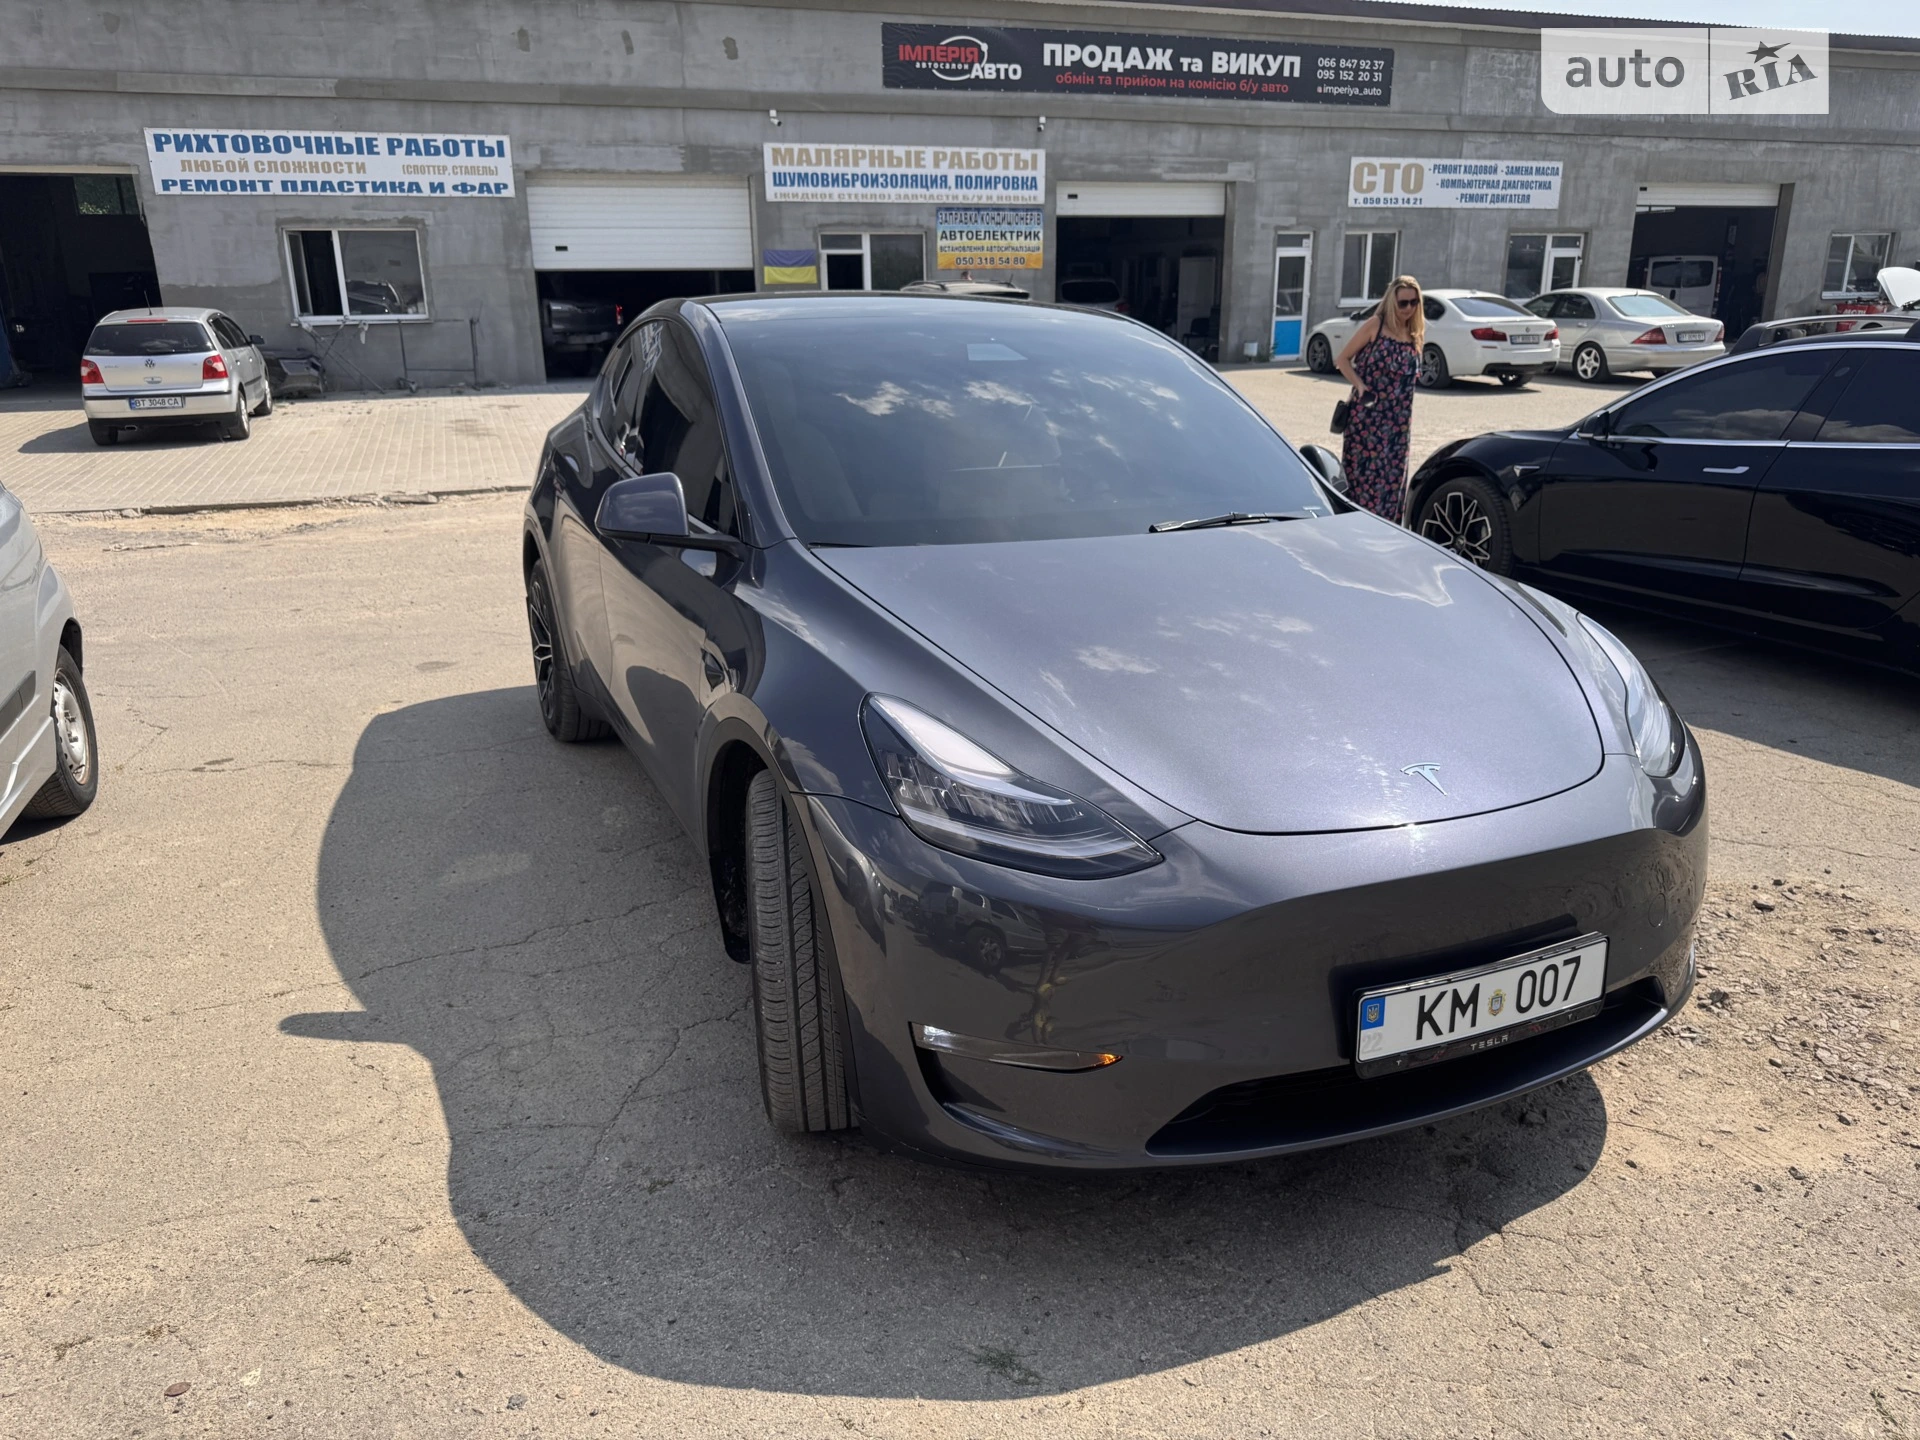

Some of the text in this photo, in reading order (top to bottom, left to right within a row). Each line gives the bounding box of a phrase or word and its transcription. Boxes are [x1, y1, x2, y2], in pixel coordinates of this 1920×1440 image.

[899, 44, 980, 63] ІМПЕРІЯ
[1043, 43, 1301, 78] ПРОДАЖ та ВИКУП
[915, 62, 969, 70] автосалон
[970, 62, 1022, 80] АВТО
[1317, 57, 1385, 70] 066 847 92 37
[1055, 72, 1289, 94] обмін та прийом на комісію б/у авто
[1317, 69, 1382, 82] 095 152 20 31
[153, 133, 505, 158] РИХТОВОЧНЫЕ РАБОТЫ
[180, 157, 250, 173] ЛЮБОЙ
[254, 160, 367, 175] СЛОЖНОСТИ
[771, 147, 1038, 171] МАЛЯРНЫЕ РАБОТЫ
[1353, 162, 1425, 195] СТО
[1432, 164, 1462, 174] РЕМОНТ
[1463, 163, 1498, 176] ХОДОВОЙ
[1505, 165, 1533, 176] ЗАМЕНА
[1534, 166, 1559, 177] МАСЛА
[161, 178, 509, 195] РЕМОНТ ПЛАСТИКА И ФАР
[772, 171, 1038, 192] ШУМОВИБРОИЗОЛЯЦИЯ, ПОЛИРОВКА
[1440, 178, 1500, 189] КОМПЬЮТЕРНАЯ
[1501, 179, 1552, 191] ДИАГНОСТИКА
[1363, 197, 1381, 205] 050
[1383, 197, 1399, 205] 513
[1401, 197, 1411, 205] 14
[1412, 197, 1423, 205] 21
[1459, 193, 1489, 203] РЕМОНТ
[1489, 193, 1531, 205] ДВИГАТЕЛЯ
[940, 230, 1041, 241] АВТОЕЛЕКТРИК
[955, 256, 1026, 265] 050 318 54 80
[1415, 955, 1581, 1041] KM 007
[1470, 1035, 1509, 1051] TESLA
